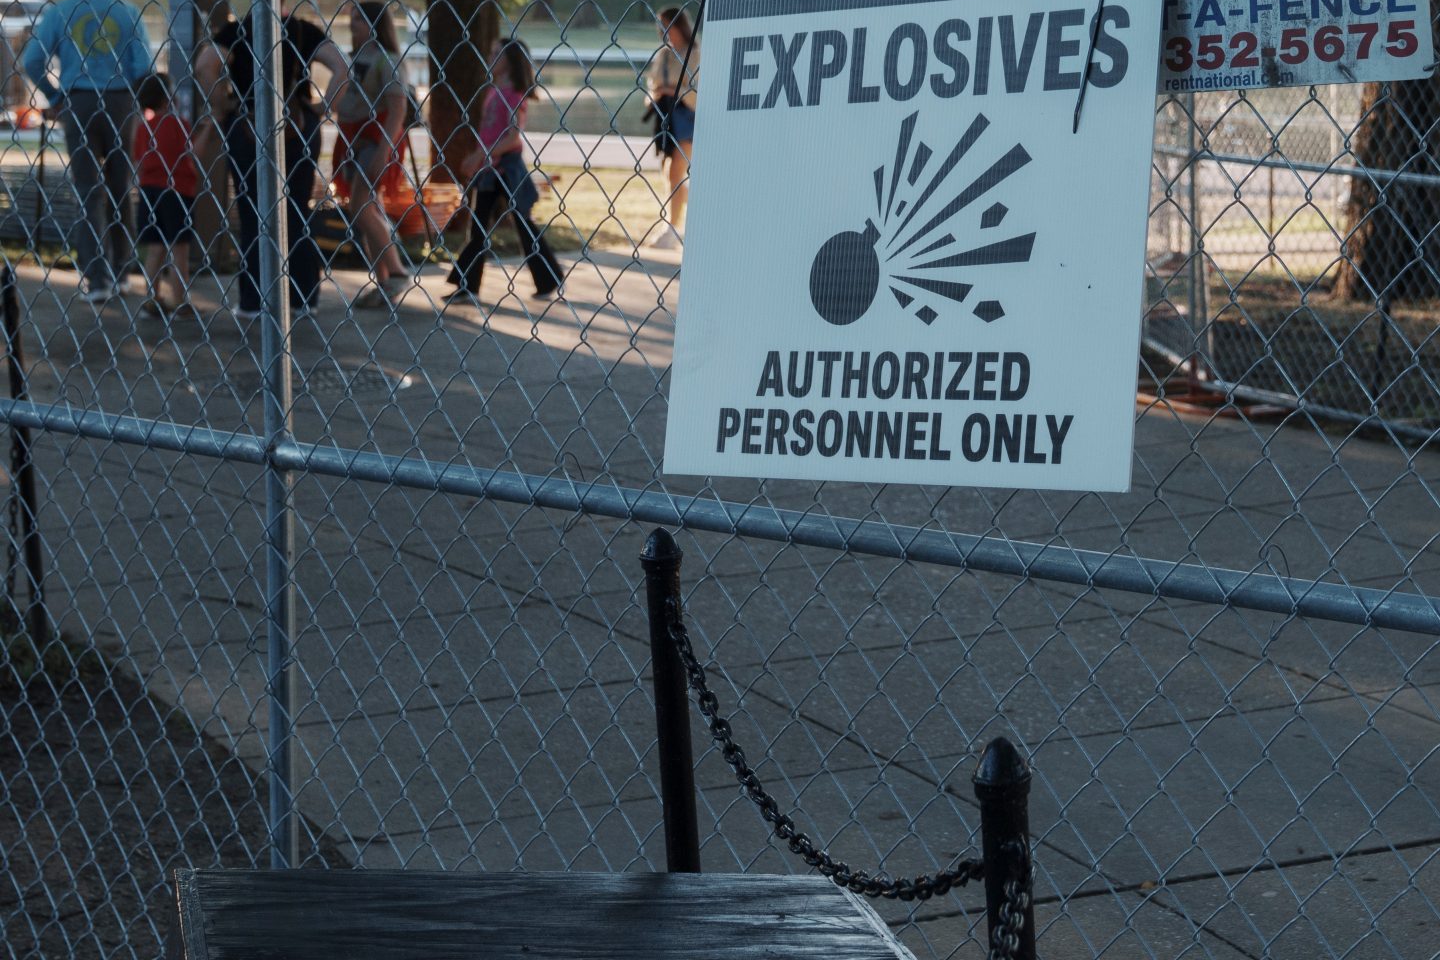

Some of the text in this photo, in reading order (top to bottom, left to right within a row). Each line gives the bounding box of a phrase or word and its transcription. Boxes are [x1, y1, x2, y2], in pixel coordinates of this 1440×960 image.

[726, 5, 1130, 111] EXPLOSIVES
[756, 350, 1030, 402] AUTHORIZED
[716, 408, 1075, 465] PERSONNEL ONLY
